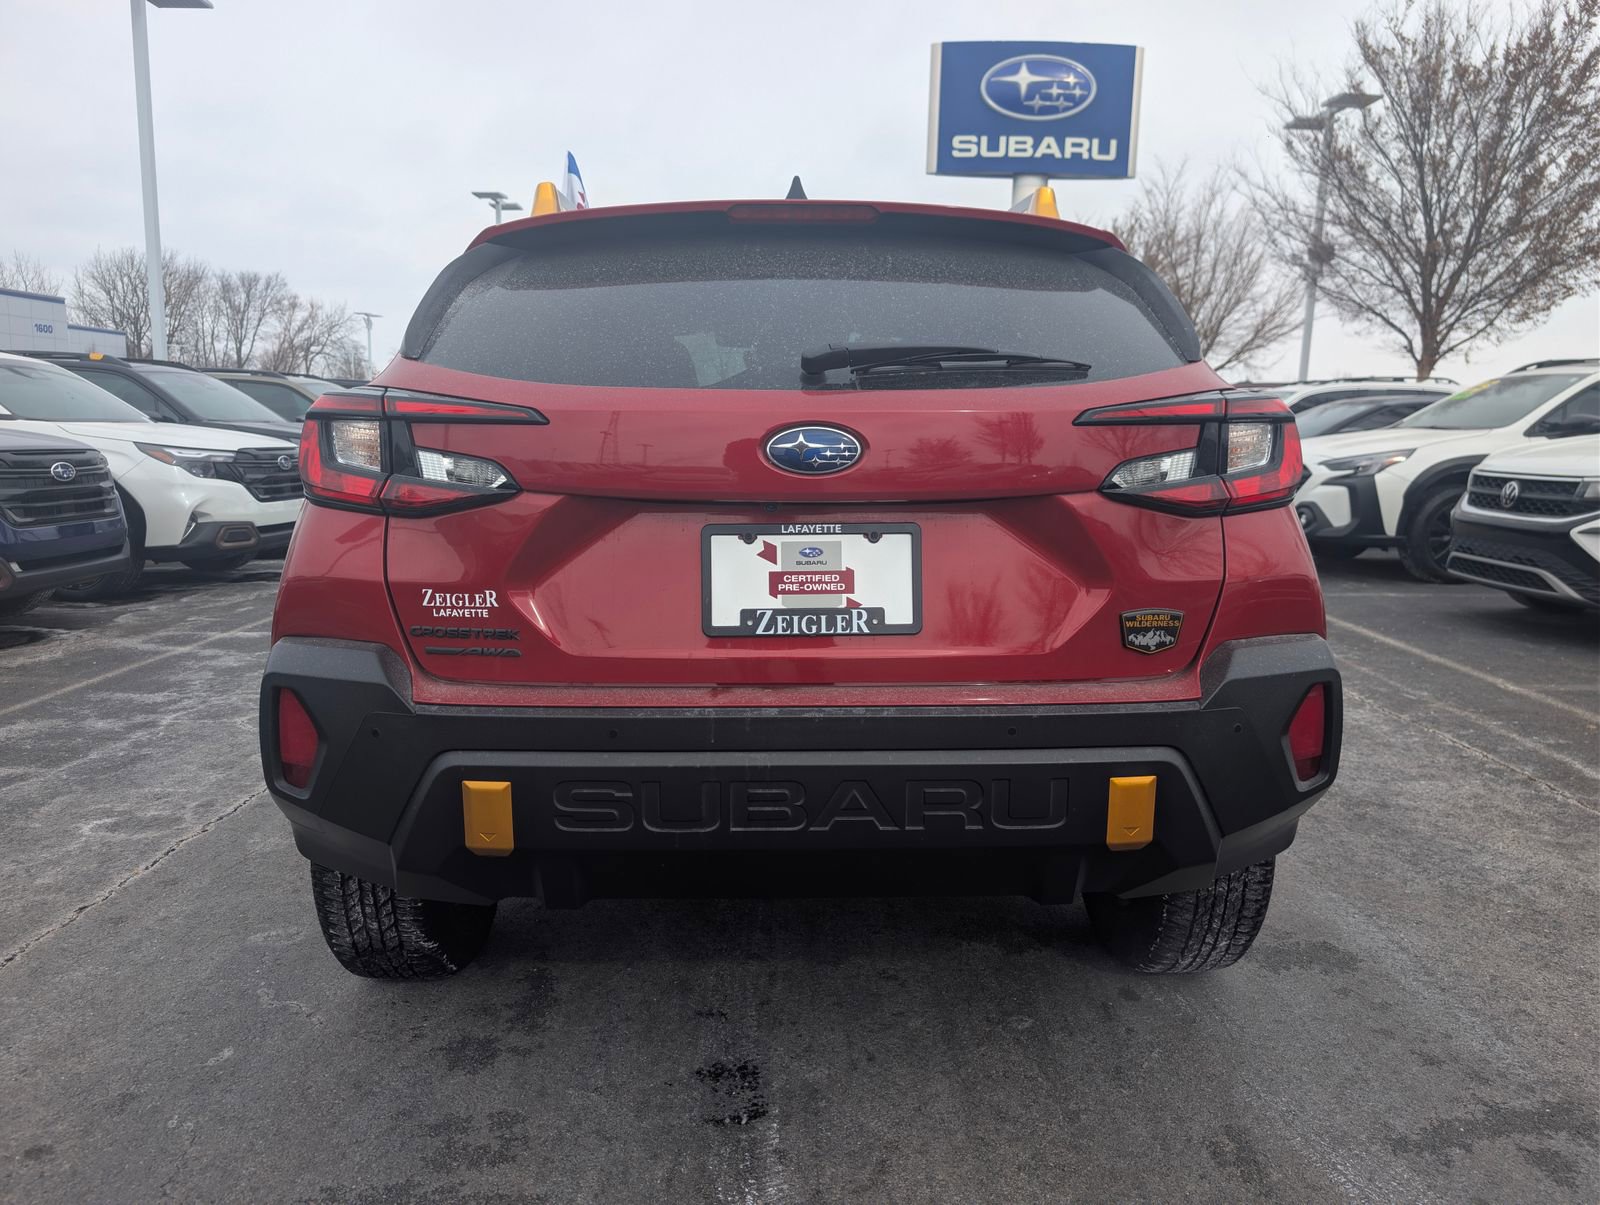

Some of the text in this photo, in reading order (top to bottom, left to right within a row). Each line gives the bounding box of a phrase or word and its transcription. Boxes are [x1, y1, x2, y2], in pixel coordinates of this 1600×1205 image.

[951, 134, 1118, 162] SUBARU
[780, 524, 842, 534] LAFAYETTE
[783, 574, 840, 583] CERTIFIED
[778, 583, 846, 592] PRE-OWNED
[422, 588, 499, 608] ZEIGLER
[432, 608, 489, 618] LAFAYETTE
[755, 609, 870, 635] ZEIGLER
[1125, 620, 1180, 628] WILDERNESS
[410, 625, 521, 641] CROSSTREK
[553, 777, 1070, 834] SUBARU
